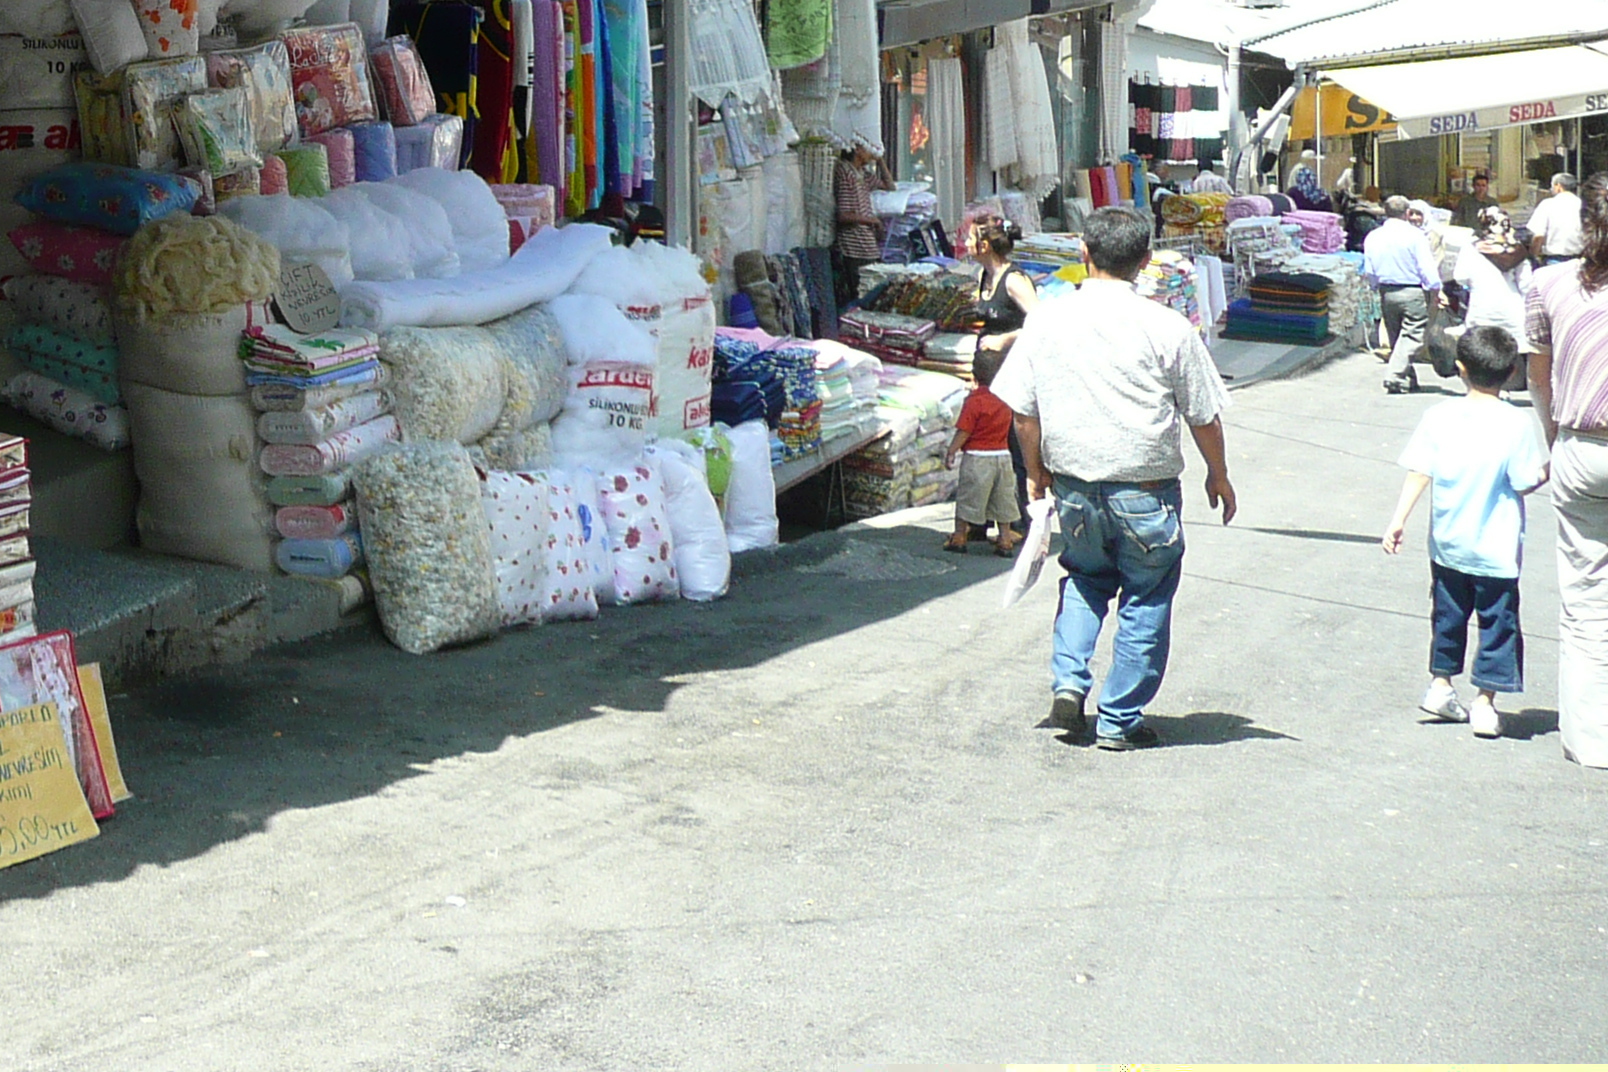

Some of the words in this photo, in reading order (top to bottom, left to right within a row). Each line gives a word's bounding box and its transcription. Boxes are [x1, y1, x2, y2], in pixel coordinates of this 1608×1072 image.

[47, 61, 66, 75] 10
[1509, 100, 1557, 123] SEDA
[1429, 112, 1479, 134] SEDA
[608, 413, 626, 427] 10
[50, 821, 79, 840] YTL
